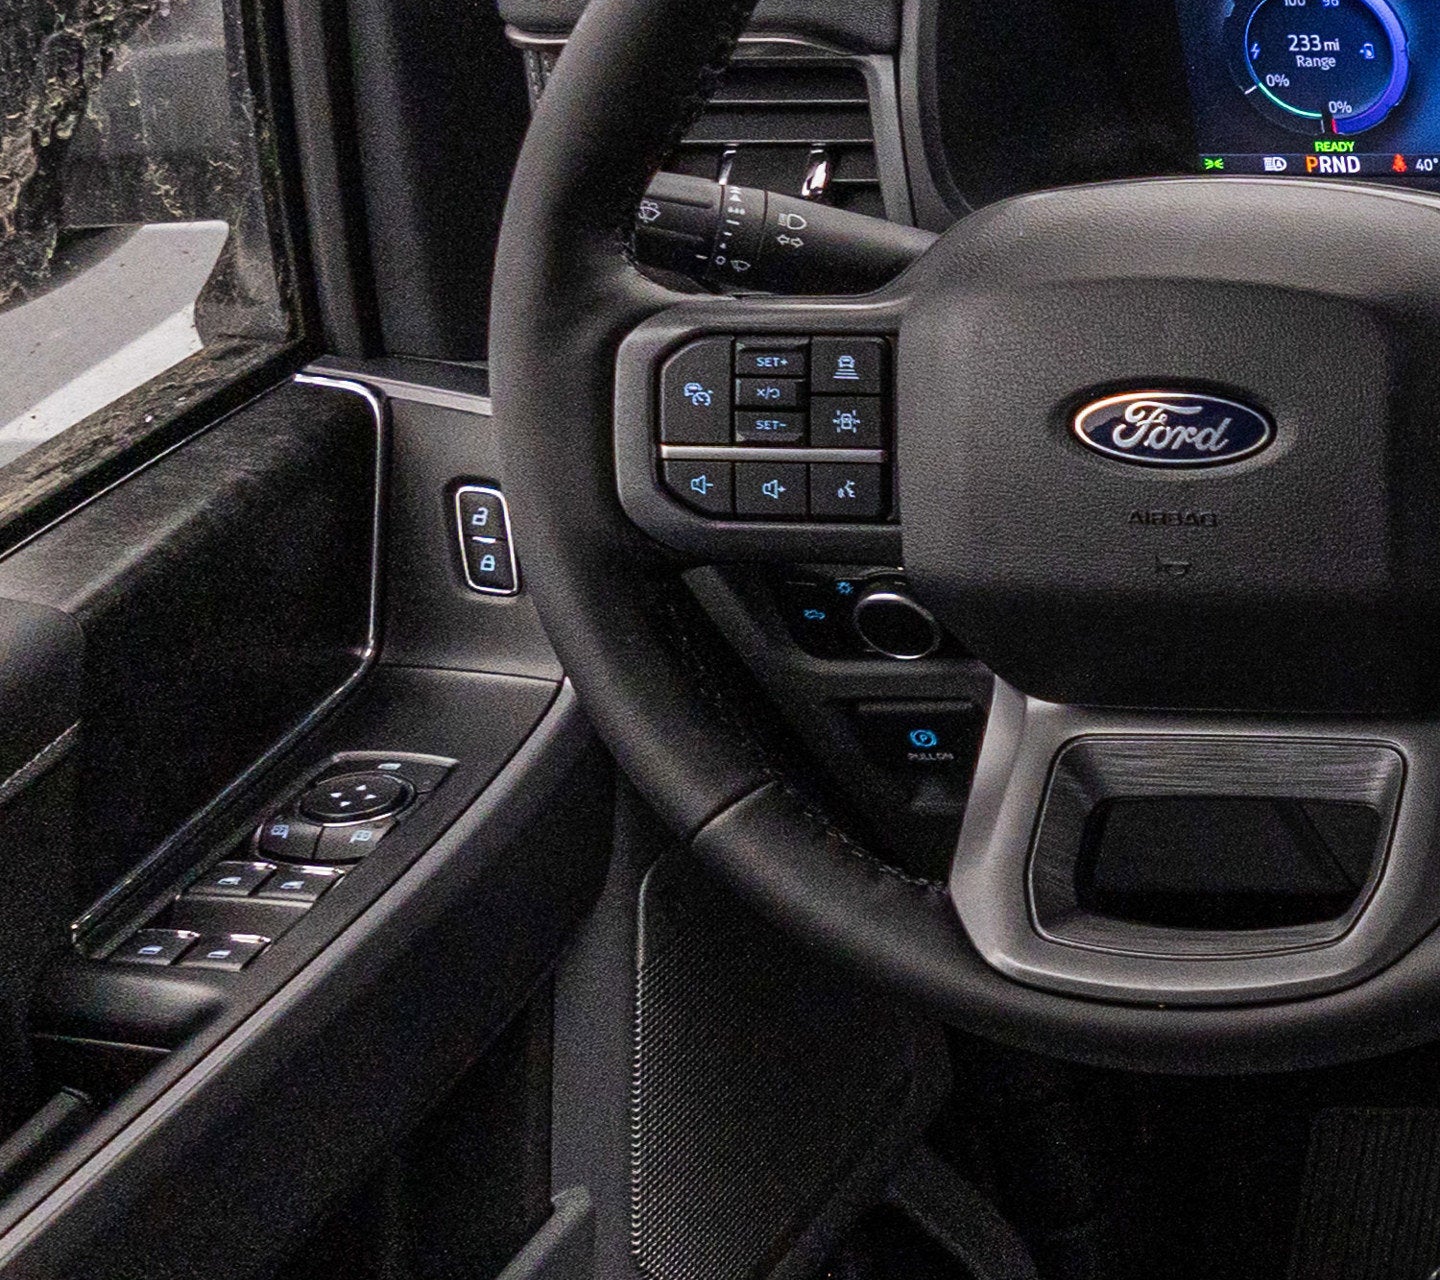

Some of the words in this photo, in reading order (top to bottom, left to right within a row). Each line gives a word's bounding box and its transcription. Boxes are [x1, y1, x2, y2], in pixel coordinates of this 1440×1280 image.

[1287, 34, 1322, 52] 233
[1323, 37, 1341, 52] mi
[1295, 55, 1337, 71] Range
[1266, 74, 1290, 88] 0%
[1328, 101, 1353, 115] 0%
[1314, 141, 1356, 153] READY
[1305, 155, 1361, 174] PRND
[1415, 158, 1439, 171] 40°
[1111, 400, 1231, 452] Ford
